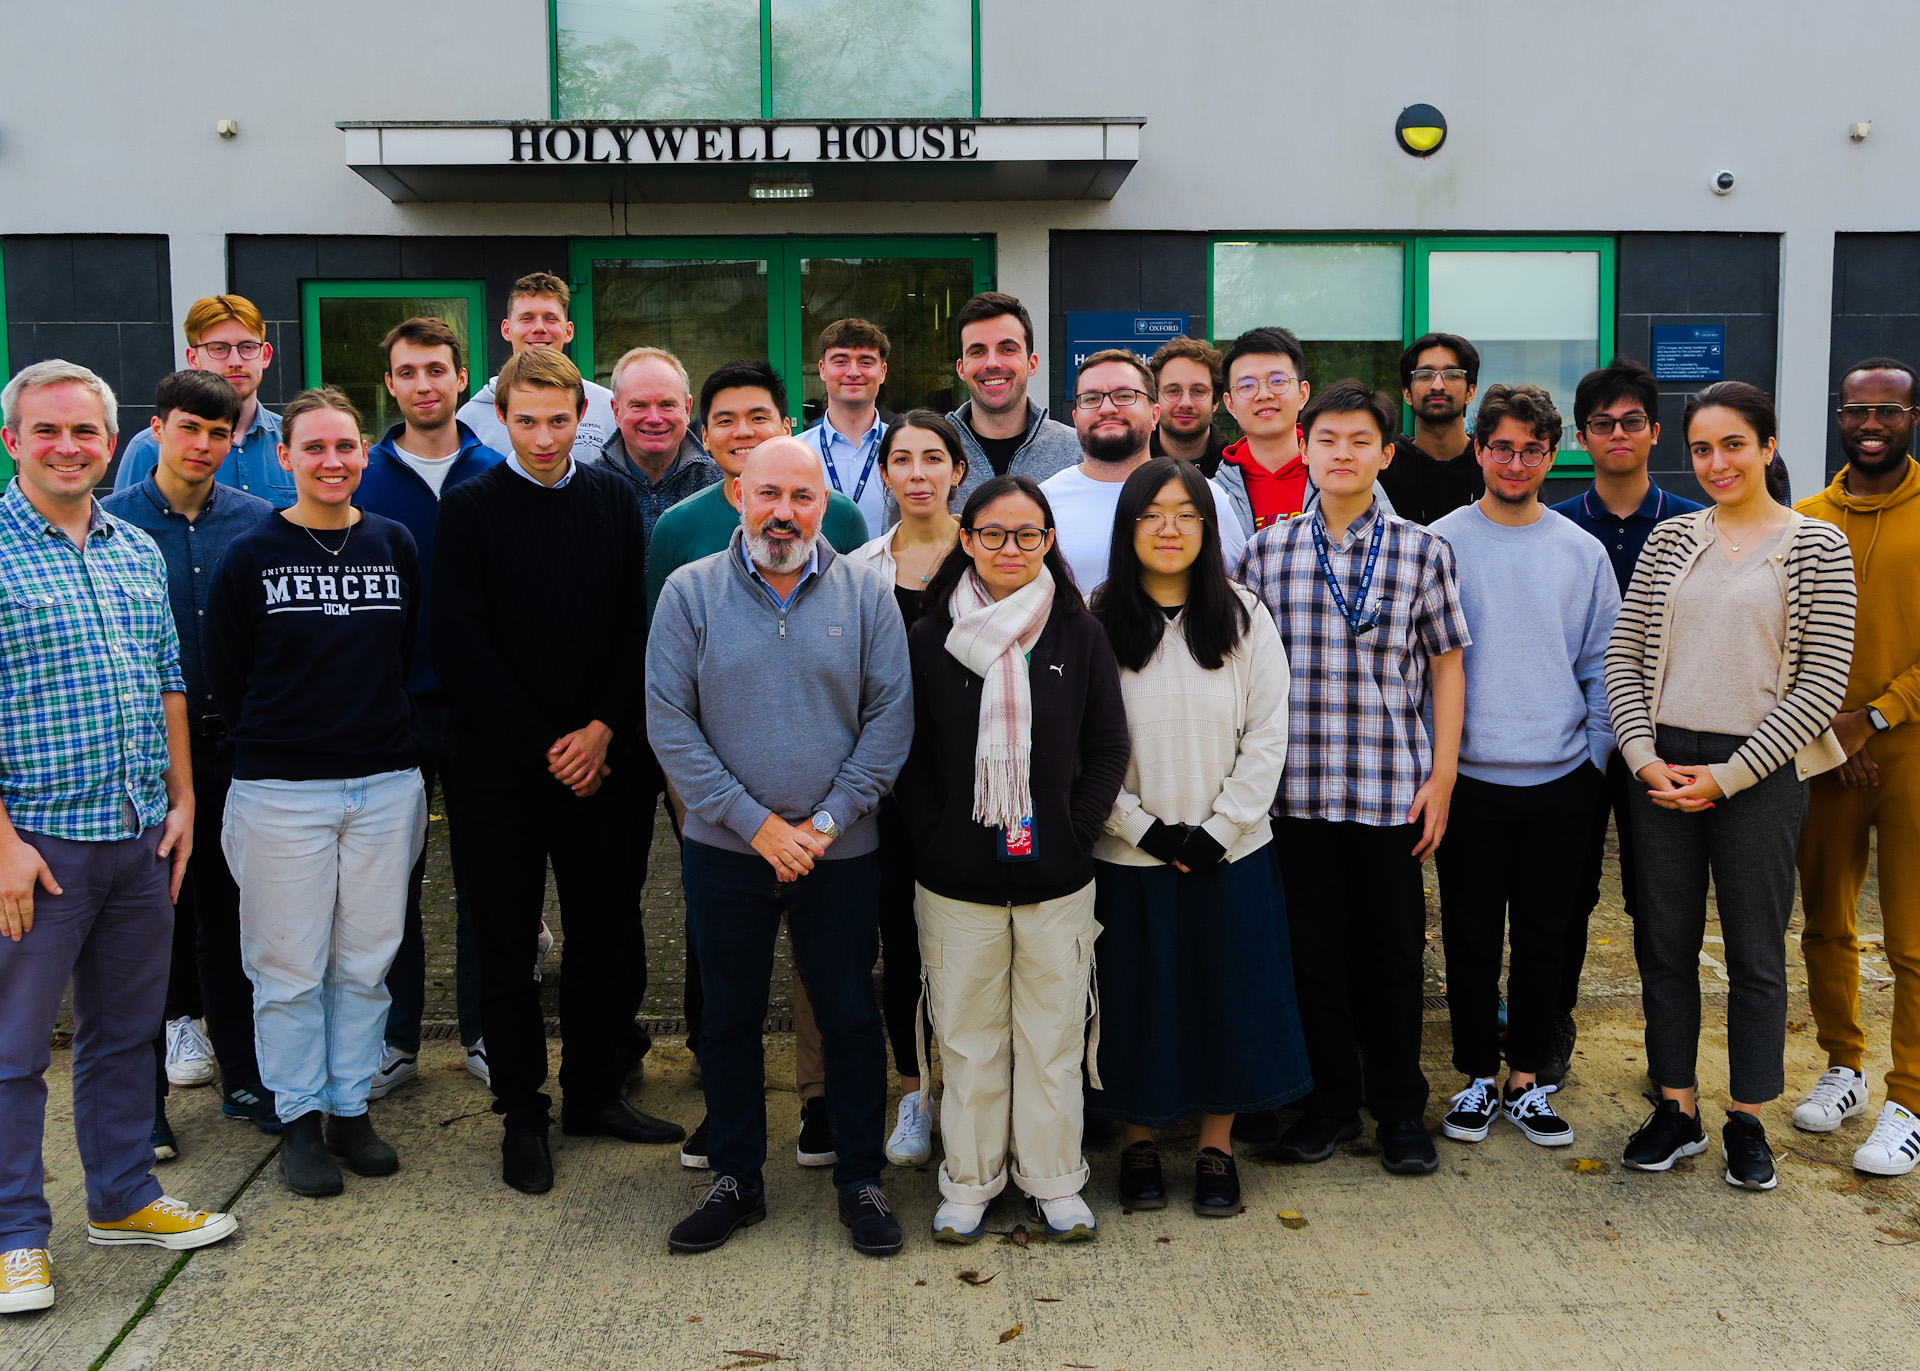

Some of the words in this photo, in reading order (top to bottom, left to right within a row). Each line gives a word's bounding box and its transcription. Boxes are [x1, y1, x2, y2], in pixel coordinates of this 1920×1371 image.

[509, 125, 791, 162] HOLYWELL
[816, 124, 979, 161] HOUSE
[262, 565, 323, 577] UNIVERSITY
[328, 565, 339, 573] OF
[345, 565, 398, 573] CALIFORNI
[262, 574, 402, 605] MERCED
[323, 603, 350, 615] UCM
